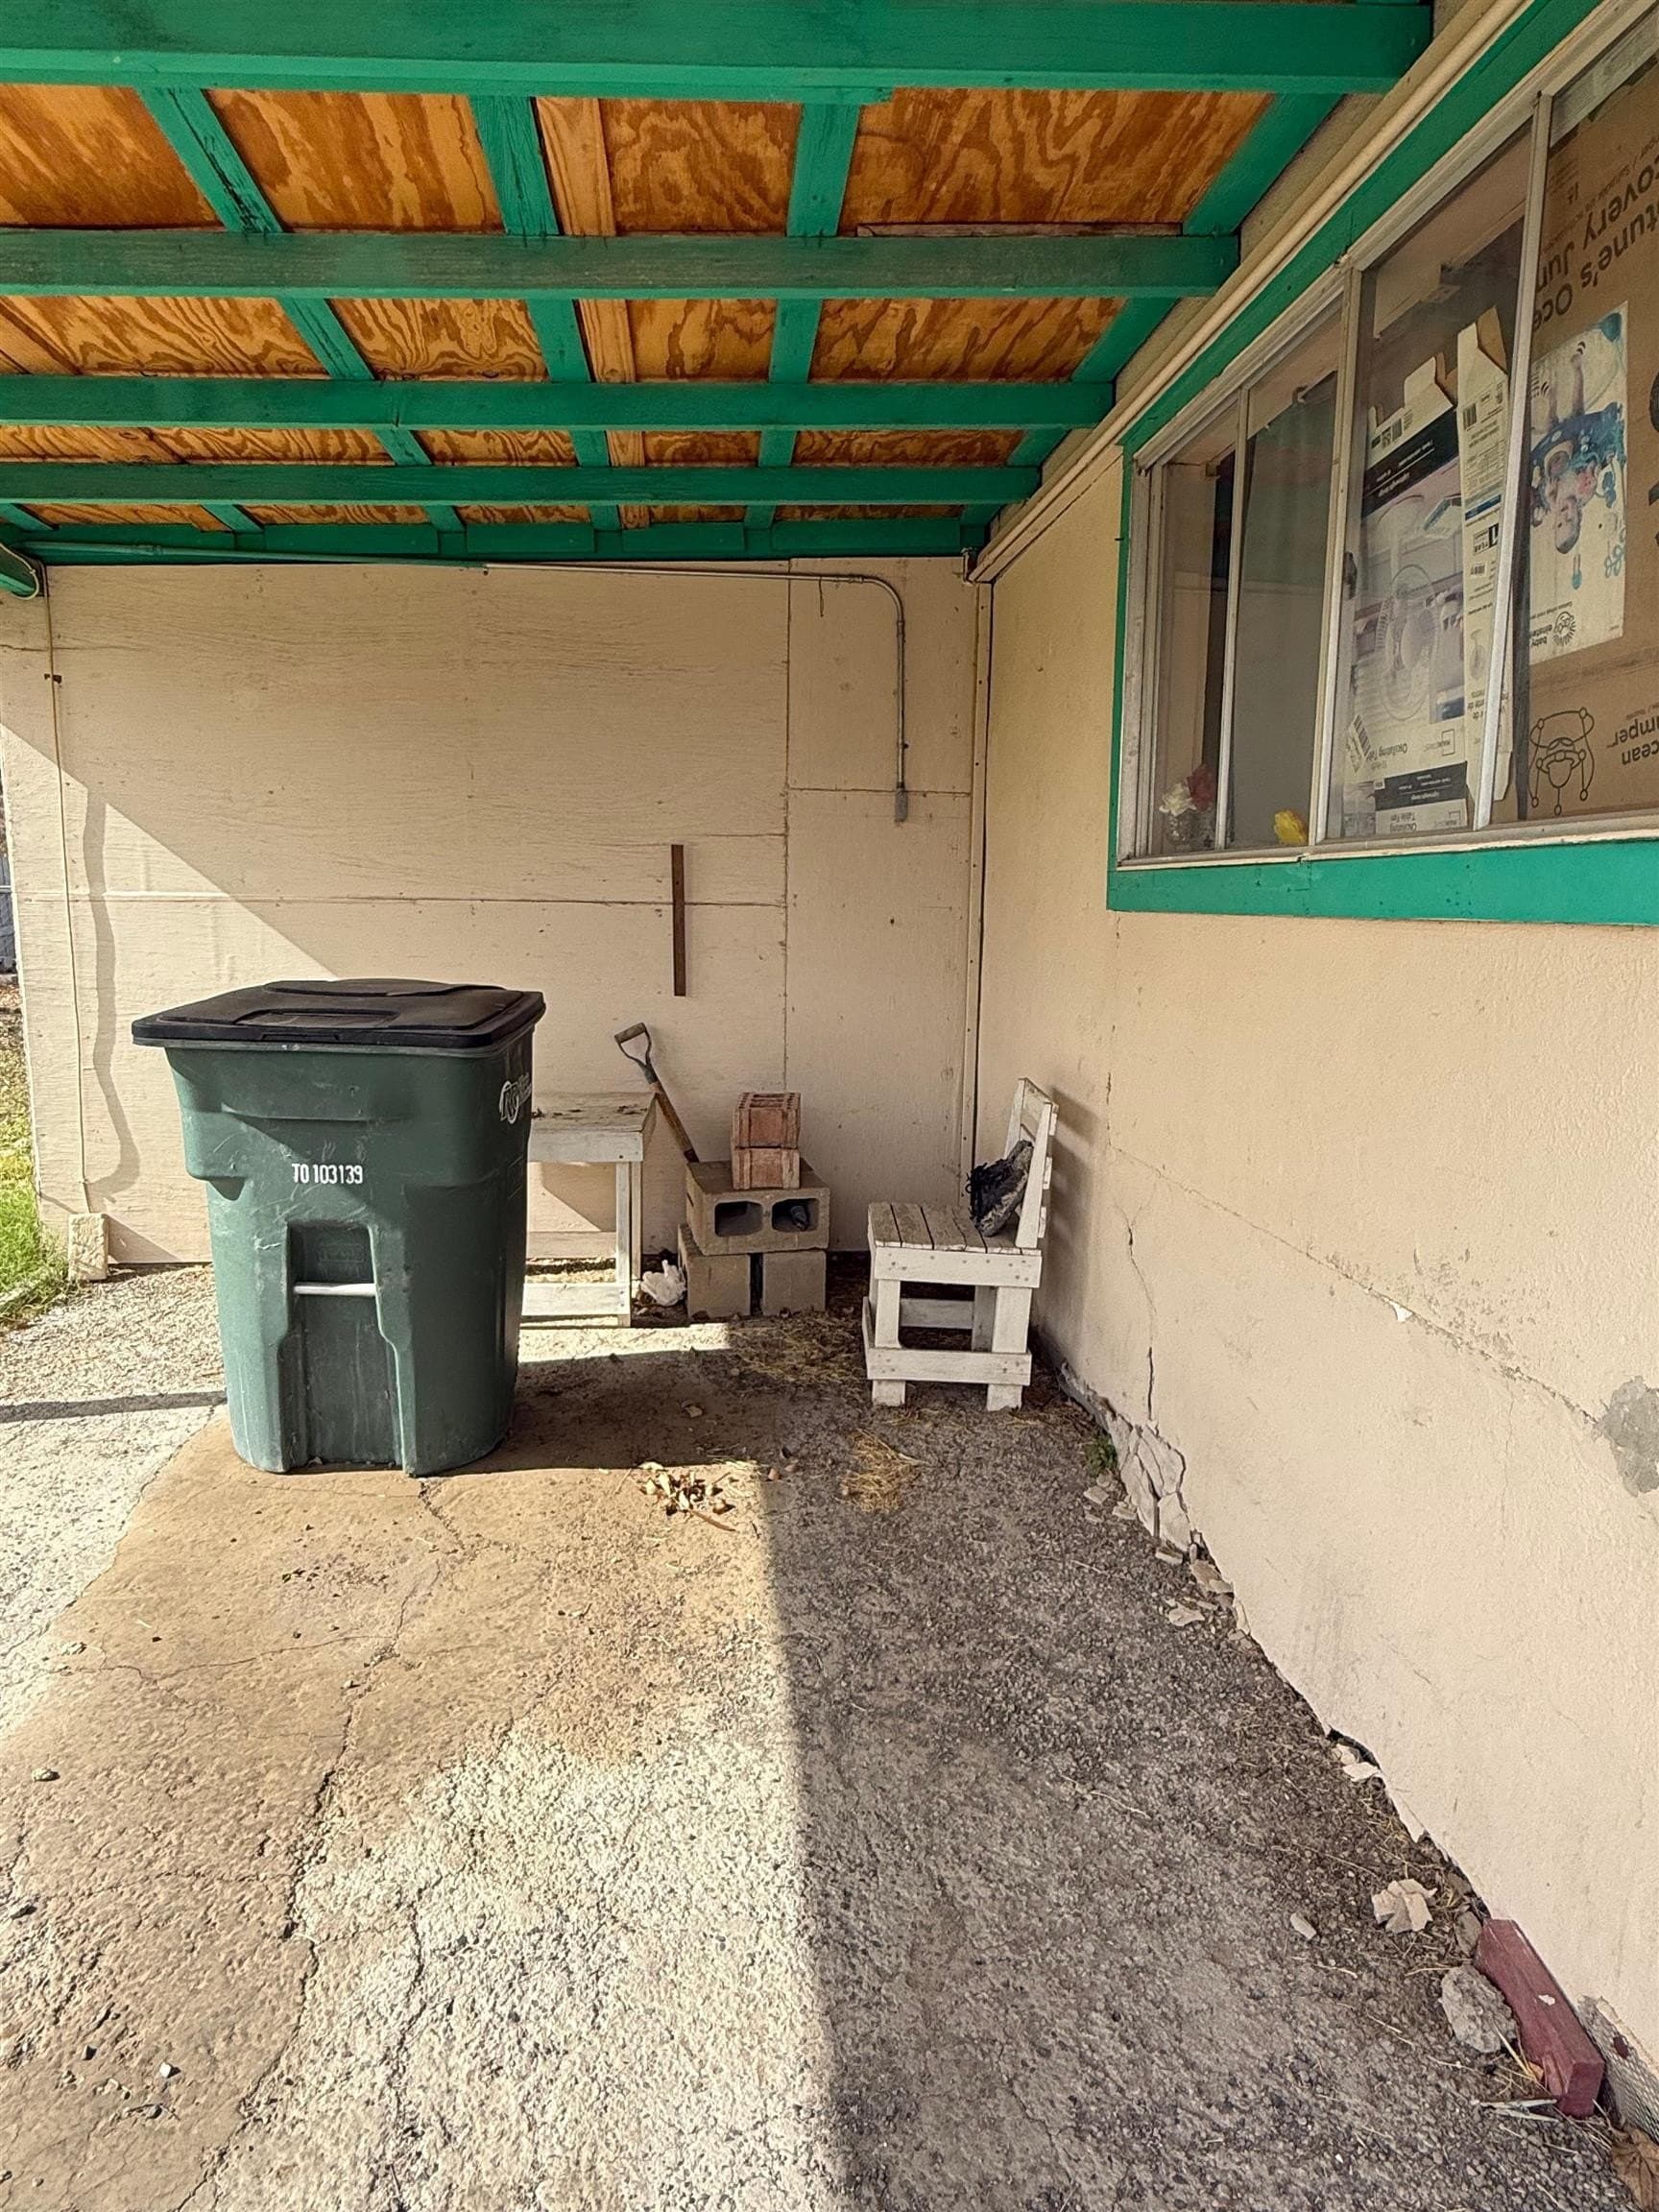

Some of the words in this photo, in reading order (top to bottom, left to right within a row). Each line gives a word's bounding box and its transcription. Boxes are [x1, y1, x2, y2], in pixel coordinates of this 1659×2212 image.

[1580, 201, 1659, 288] tune's
[1532, 283, 1573, 332] Oce
[1613, 715, 1659, 746] mper
[313, 1164, 364, 1186] 103139
